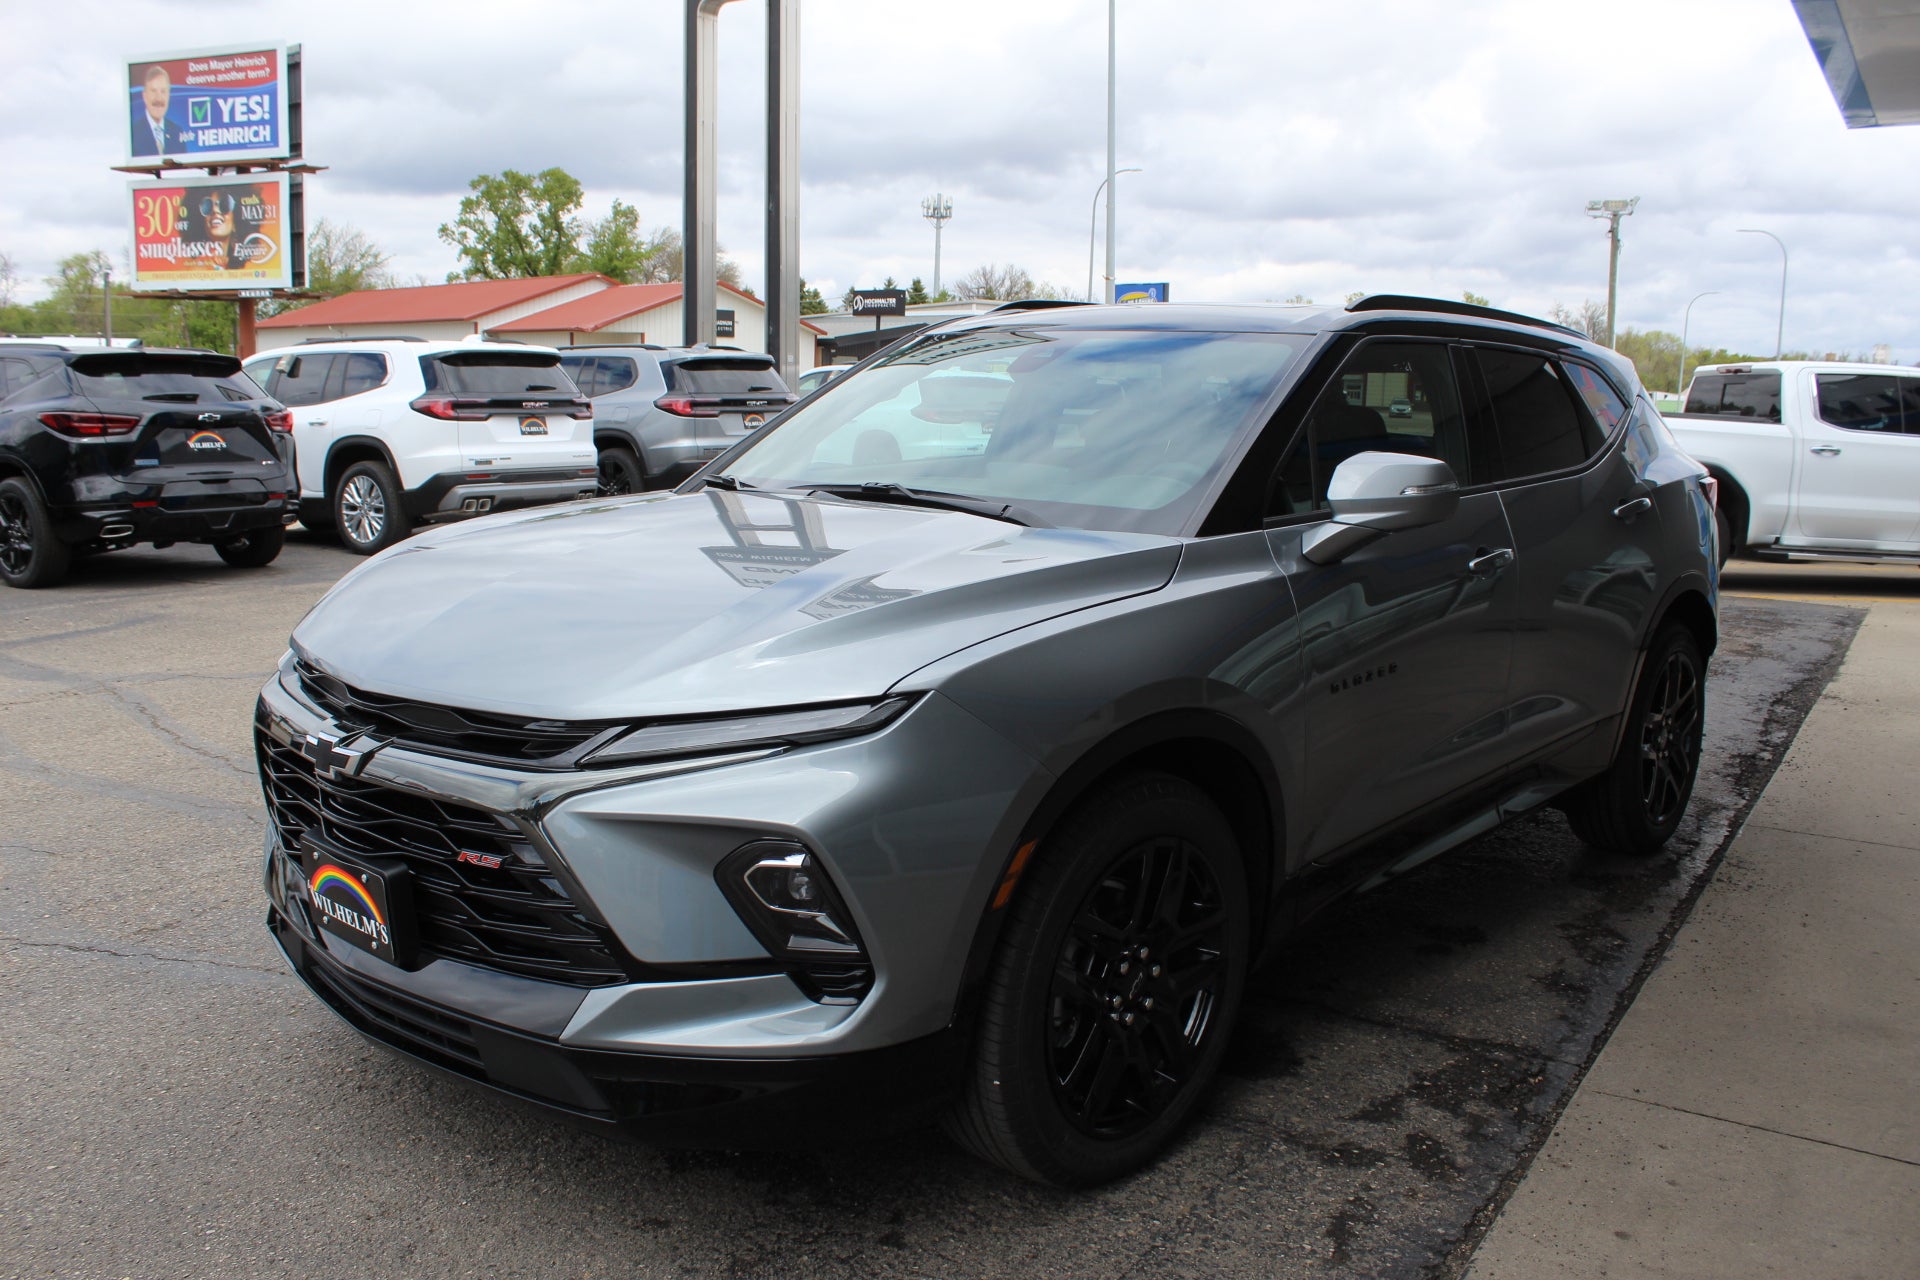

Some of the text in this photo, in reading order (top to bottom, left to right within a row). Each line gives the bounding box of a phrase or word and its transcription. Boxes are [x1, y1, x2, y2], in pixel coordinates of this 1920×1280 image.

[188, 56, 267, 73] Does Mayor Heinrich
[186, 67, 270, 84] deserve another term?
[216, 94, 270, 123] YES!
[197, 124, 271, 147] HEINRICH
[241, 205, 277, 220] MAY 31
[140, 237, 224, 264] sunglasses
[187, 441, 227, 449] WILHELM'S
[457, 850, 503, 869] RS
[309, 889, 389, 945] WILHELM'S
